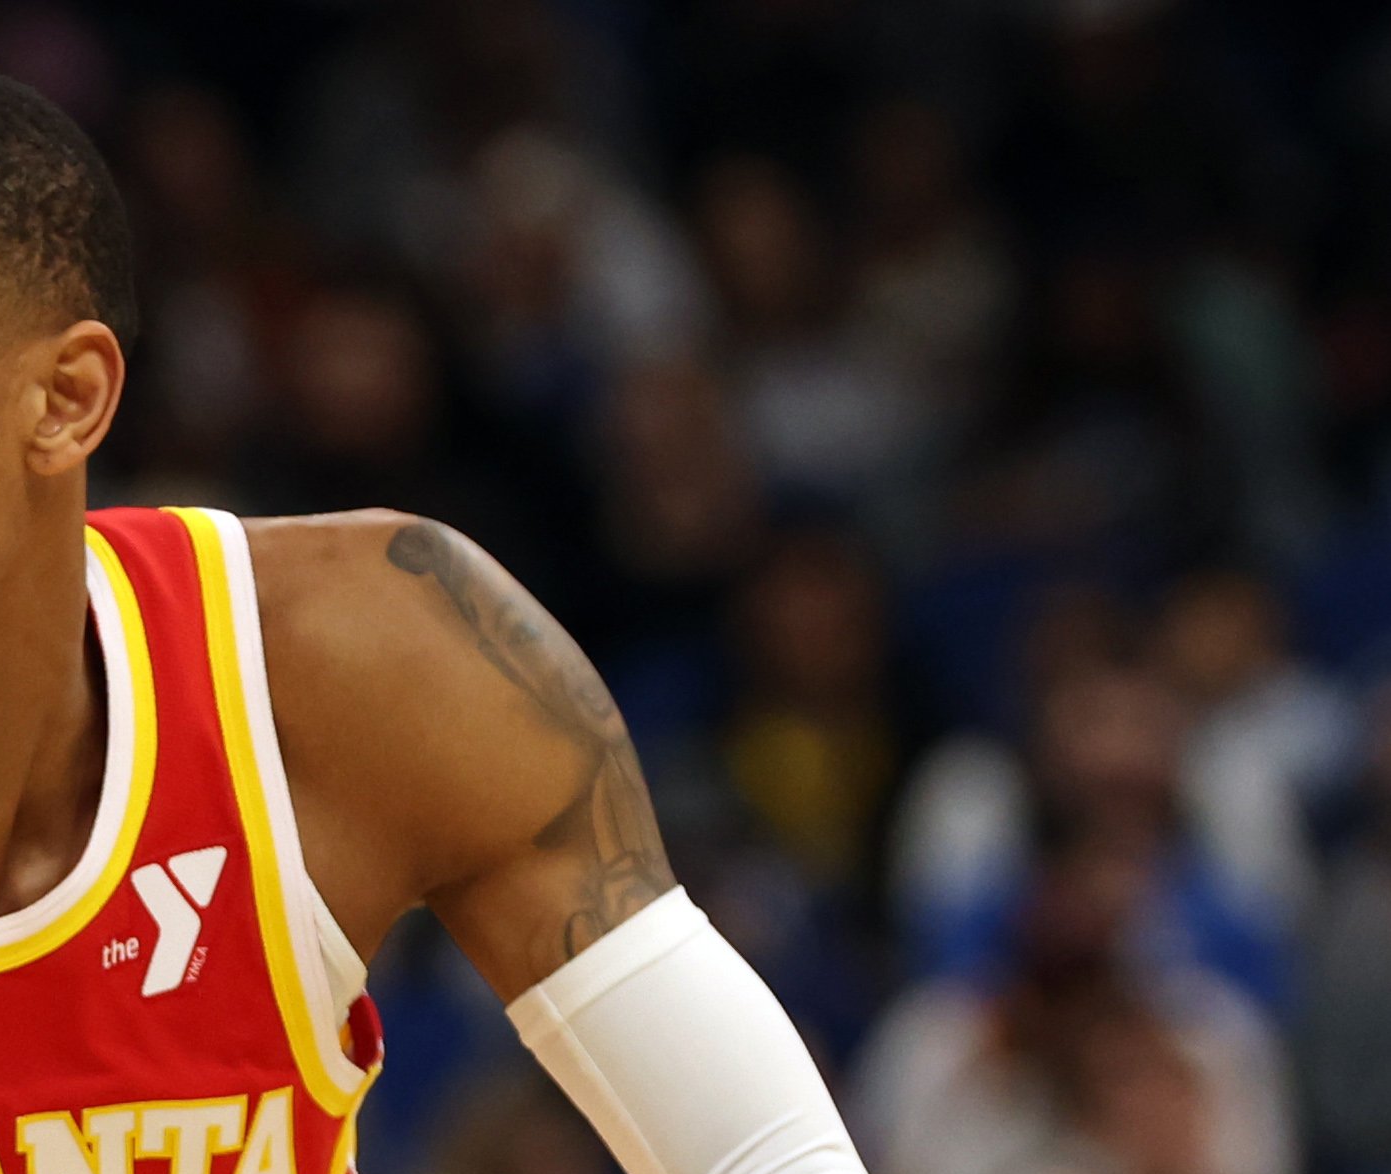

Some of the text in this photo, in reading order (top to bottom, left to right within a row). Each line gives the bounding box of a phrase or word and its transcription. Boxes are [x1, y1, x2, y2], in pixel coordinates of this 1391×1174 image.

[102, 845, 228, 998] the Y
[185, 946, 209, 983] YMCA
